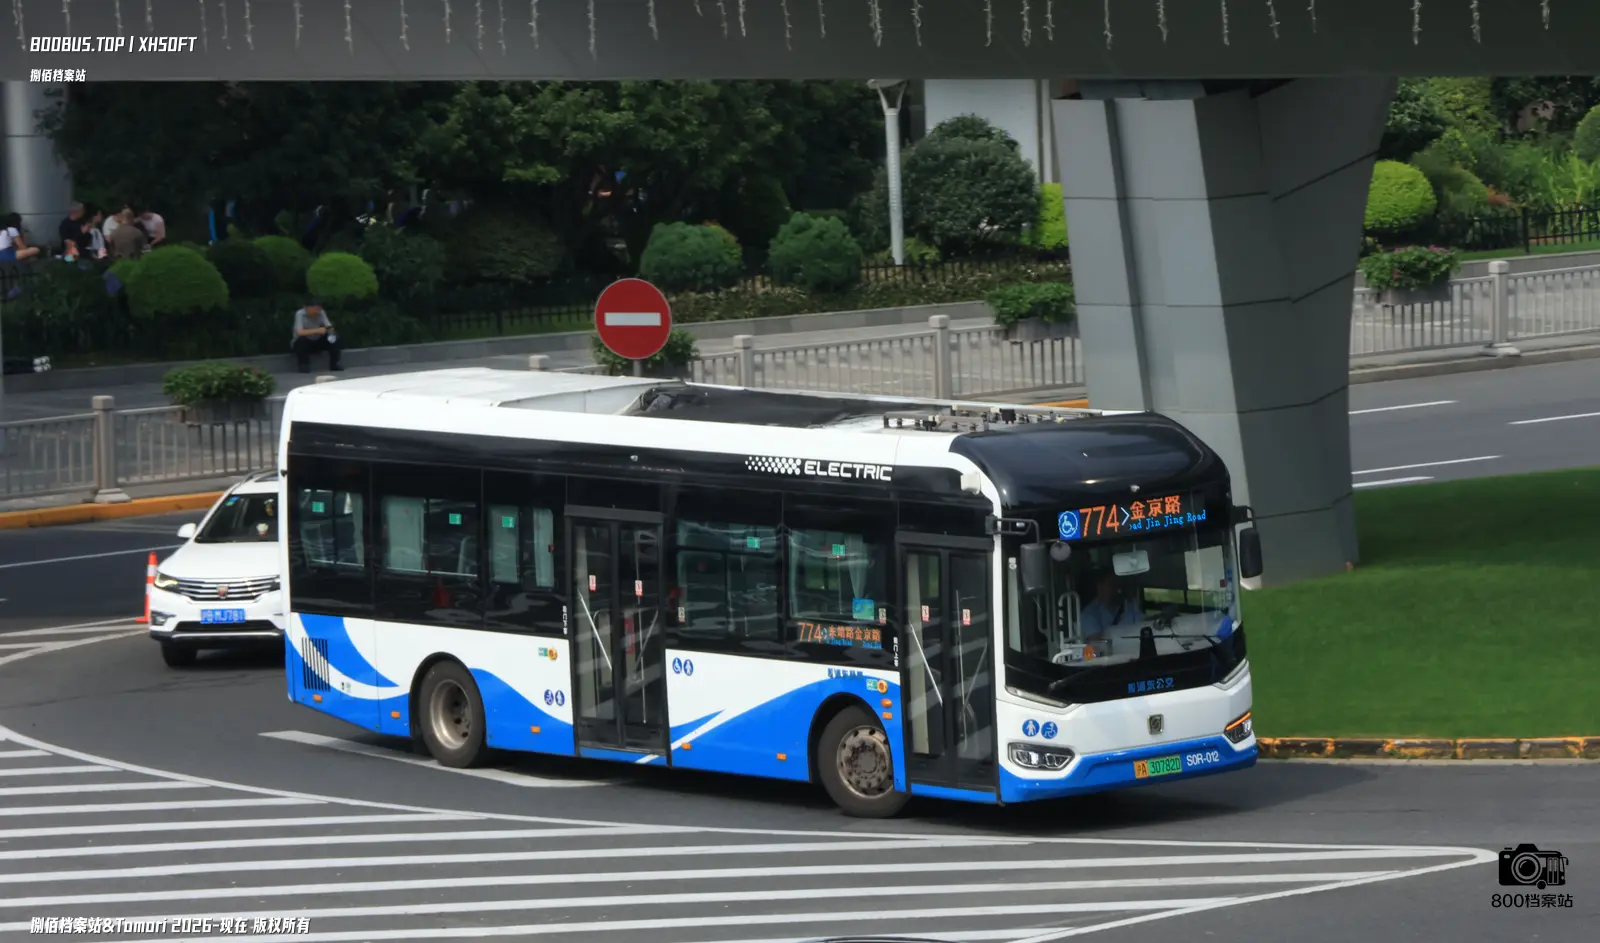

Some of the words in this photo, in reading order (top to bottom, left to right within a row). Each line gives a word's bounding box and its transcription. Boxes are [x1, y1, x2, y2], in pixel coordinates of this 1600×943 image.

[804, 460, 892, 481] ELECTRIC
[1080, 504, 1120, 537] 774
[1130, 495, 1182, 521] 金京路
[1146, 516, 1161, 530] Jin
[1164, 513, 1184, 528] Jing
[1187, 510, 1206, 522] Road
[798, 622, 823, 643] 774
